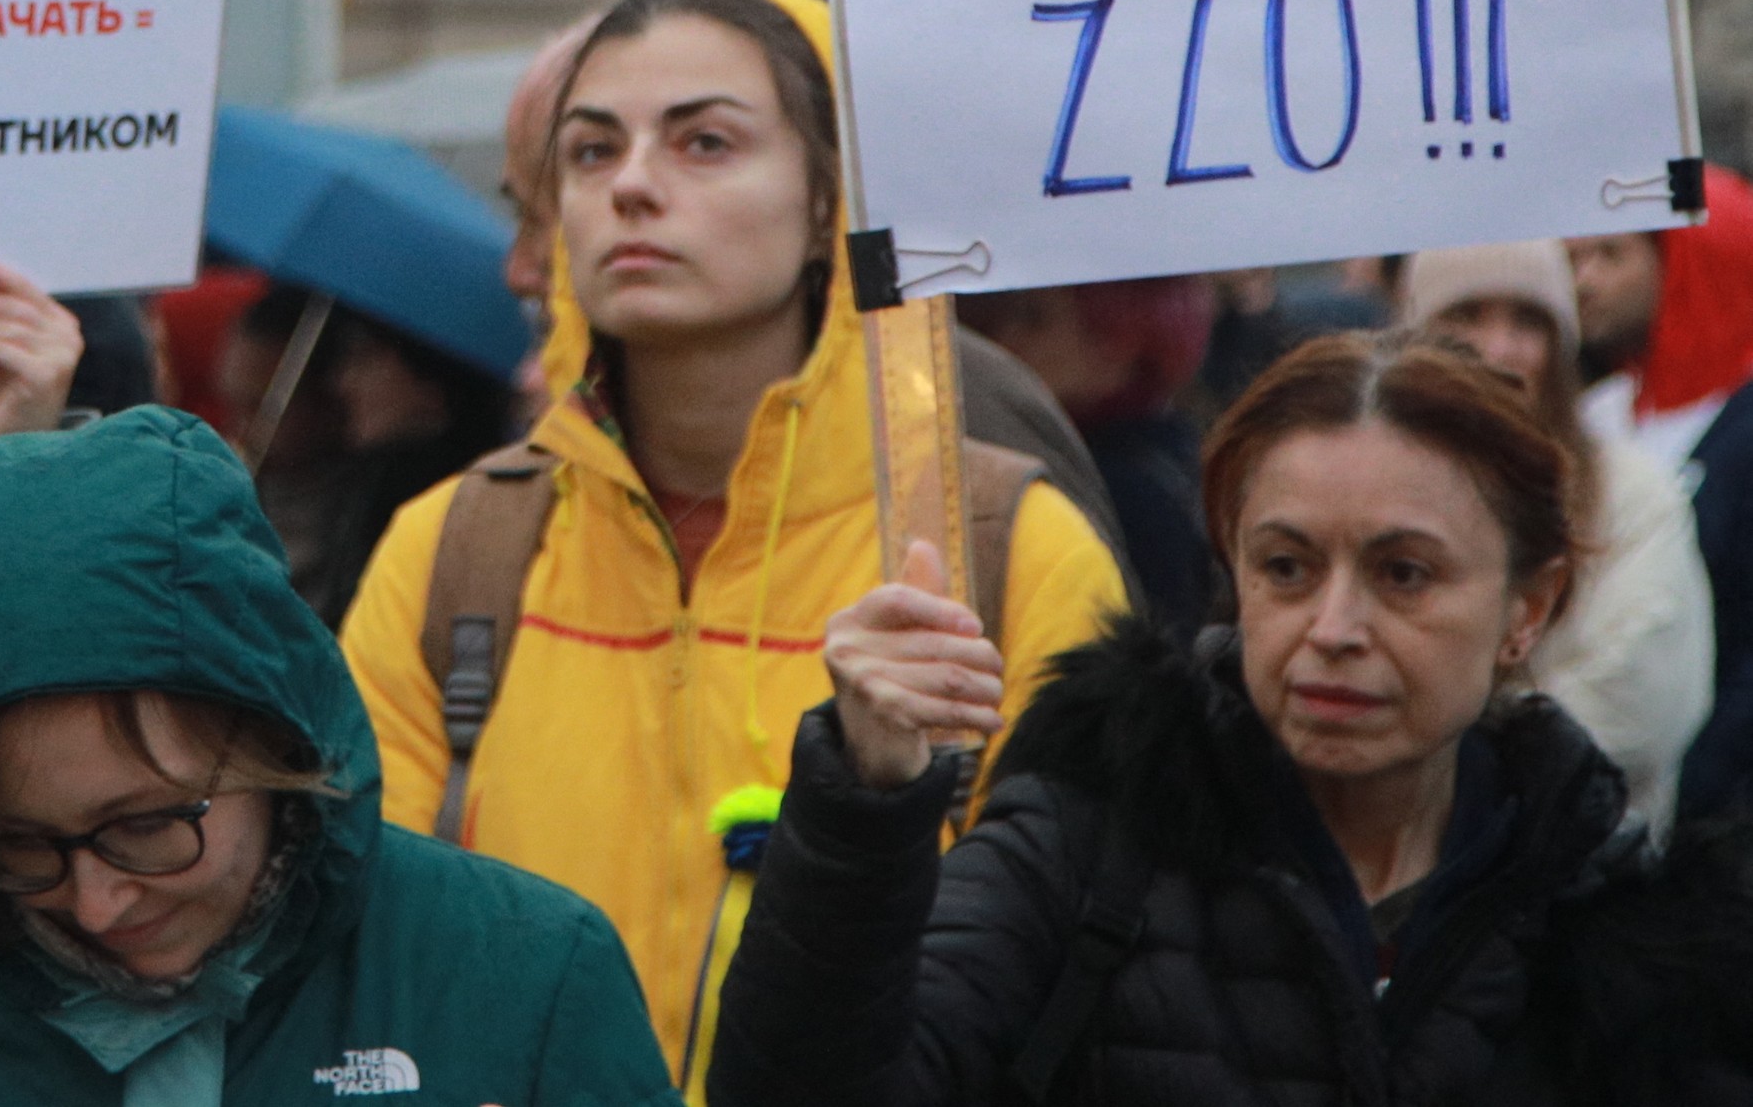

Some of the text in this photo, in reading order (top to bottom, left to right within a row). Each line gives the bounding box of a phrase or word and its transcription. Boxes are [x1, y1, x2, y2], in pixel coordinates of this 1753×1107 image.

[343, 1050, 384, 1066] THE
[313, 1065, 384, 1083] NORTH
[334, 1079, 385, 1096] FACE
